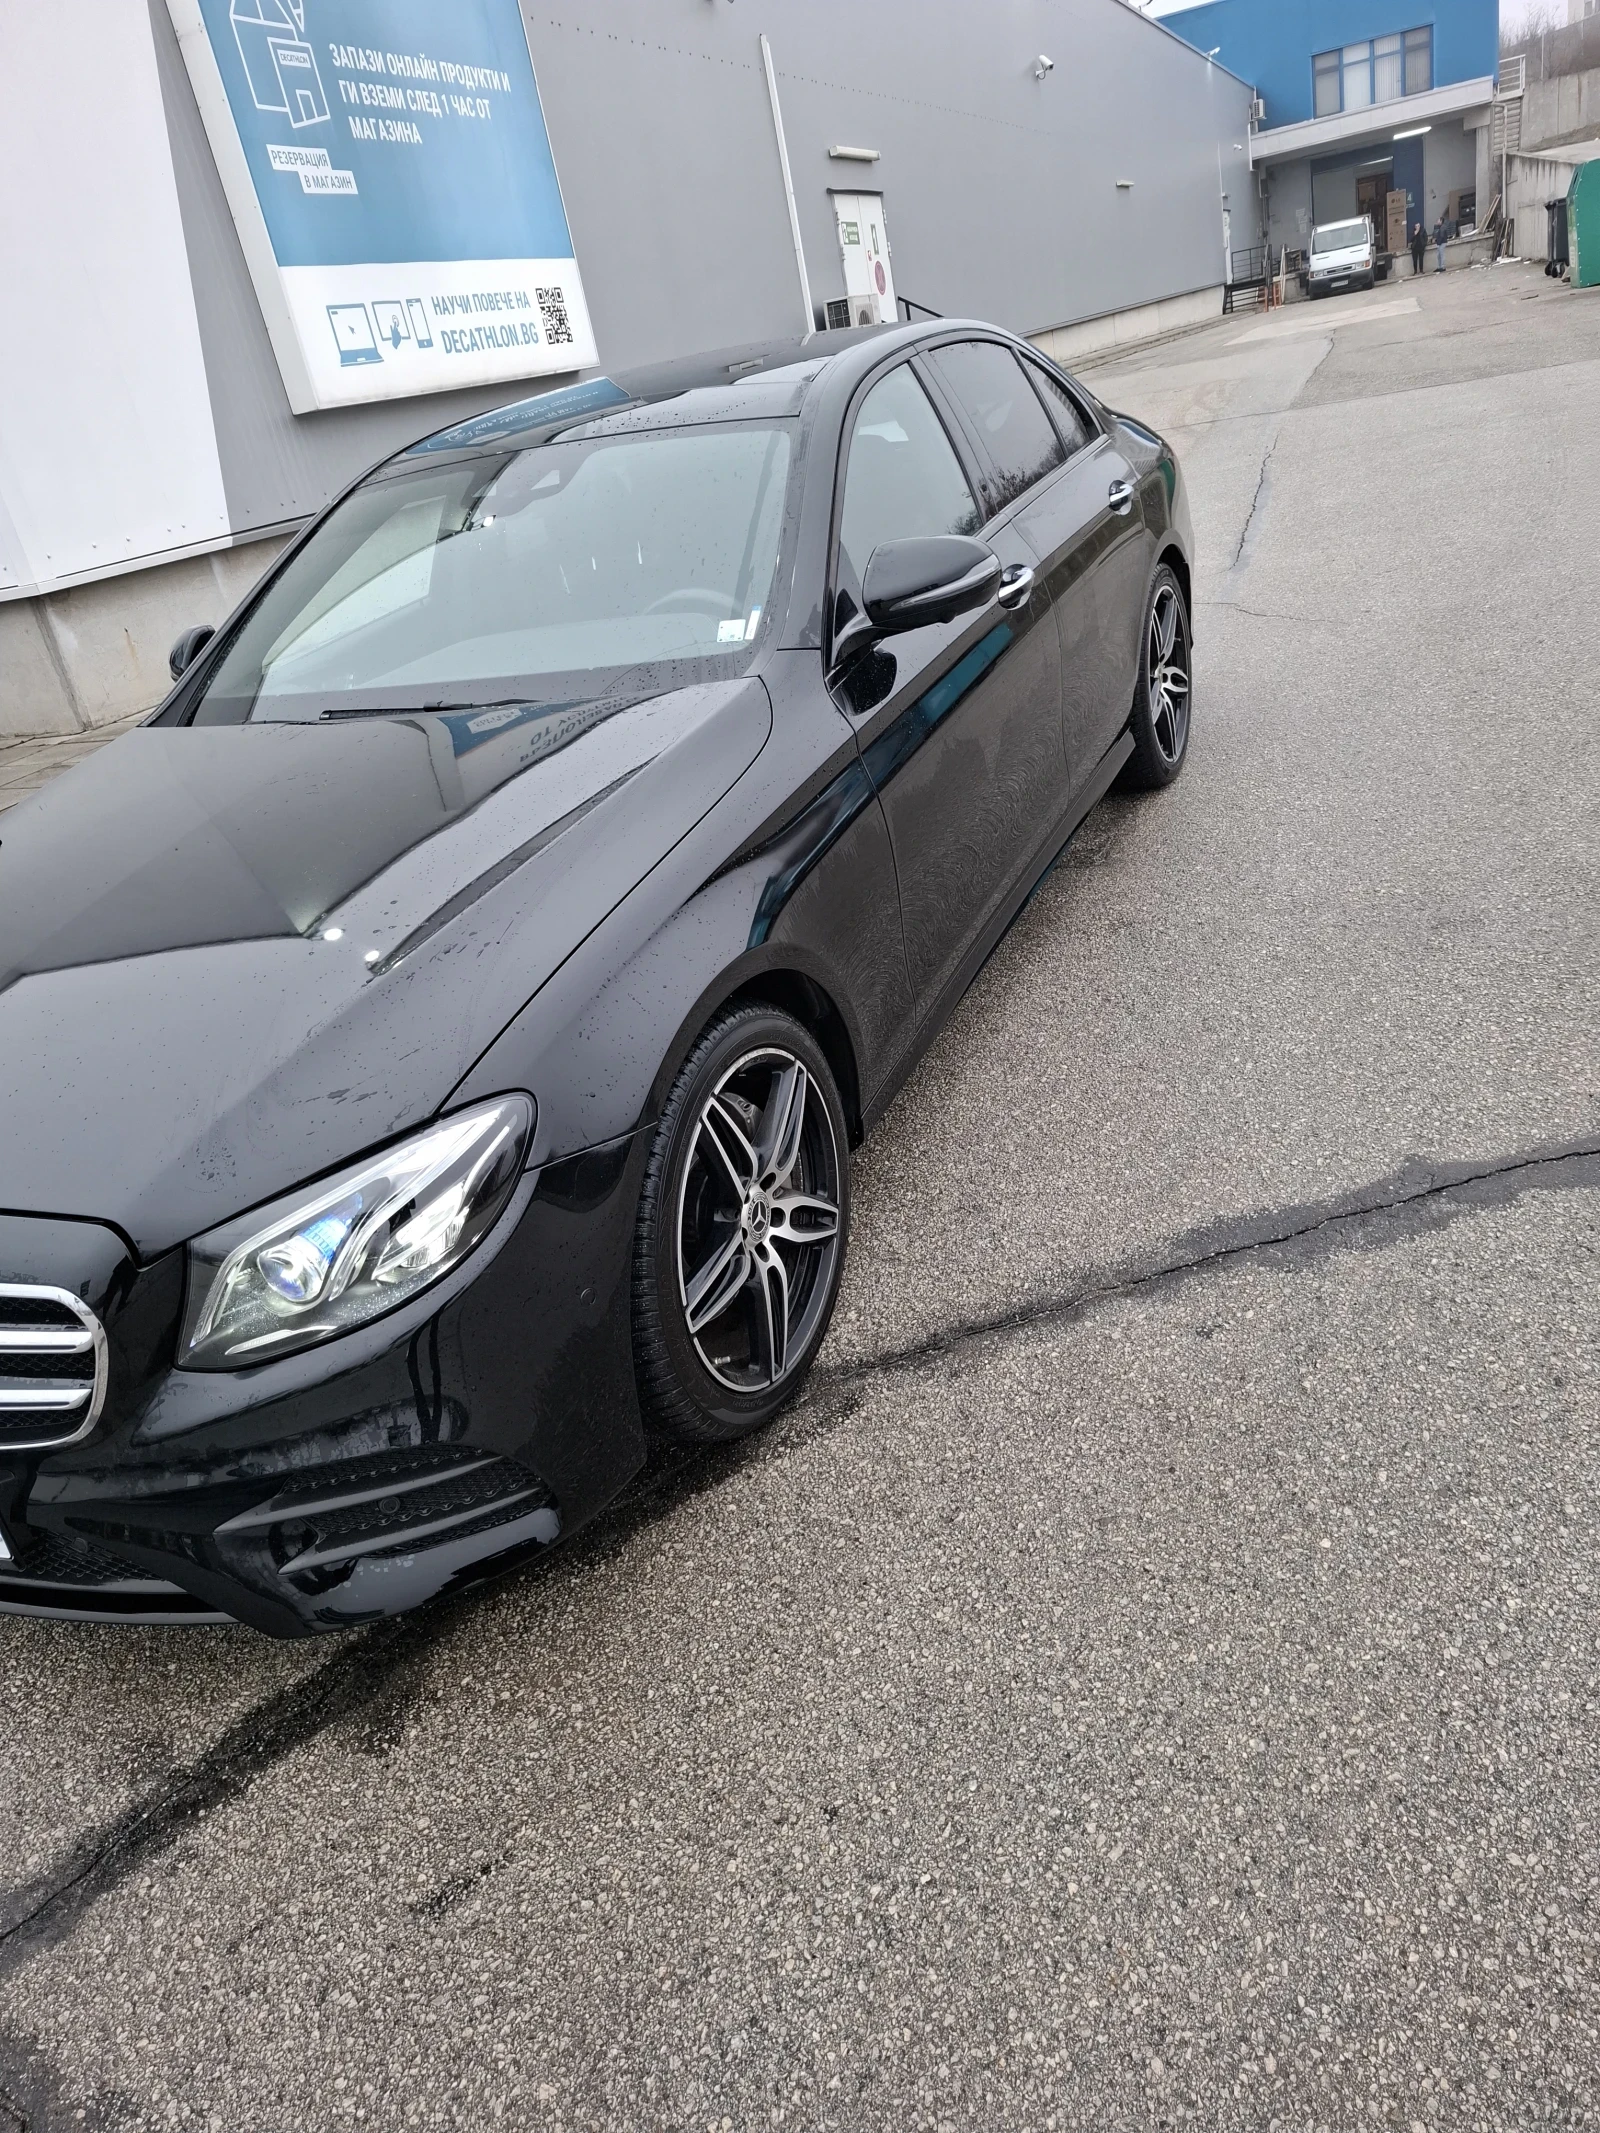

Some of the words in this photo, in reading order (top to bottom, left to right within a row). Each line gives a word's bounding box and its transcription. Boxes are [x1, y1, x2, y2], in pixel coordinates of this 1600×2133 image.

[280, 53, 308, 65] DECATHLON
[329, 43, 386, 74] ЗАПАЗИ
[386, 53, 440, 82] ОНЛАЙН
[439, 61, 502, 92] ПРОДУКТИ
[500, 71, 511, 92] И
[338, 79, 360, 105] ГИ
[358, 82, 406, 110] ВЗЕМИ
[406, 89, 443, 118] СЛЕД
[441, 93, 450, 115] 1
[449, 94, 476, 118] ЧАС
[476, 98, 492, 120] ОТ
[349, 116, 423, 144] МАГАЗИНА
[271, 150, 329, 170] РЕЗЕРВАЦИЯ
[304, 175, 312, 189] В
[313, 175, 353, 189] МАГАЗИН
[431, 294, 473, 316] НАУЧИ
[472, 291, 515, 313] ПОВЕЧЕ
[514, 291, 532, 309] НА
[440, 322, 539, 354] DECATHLON.BG
